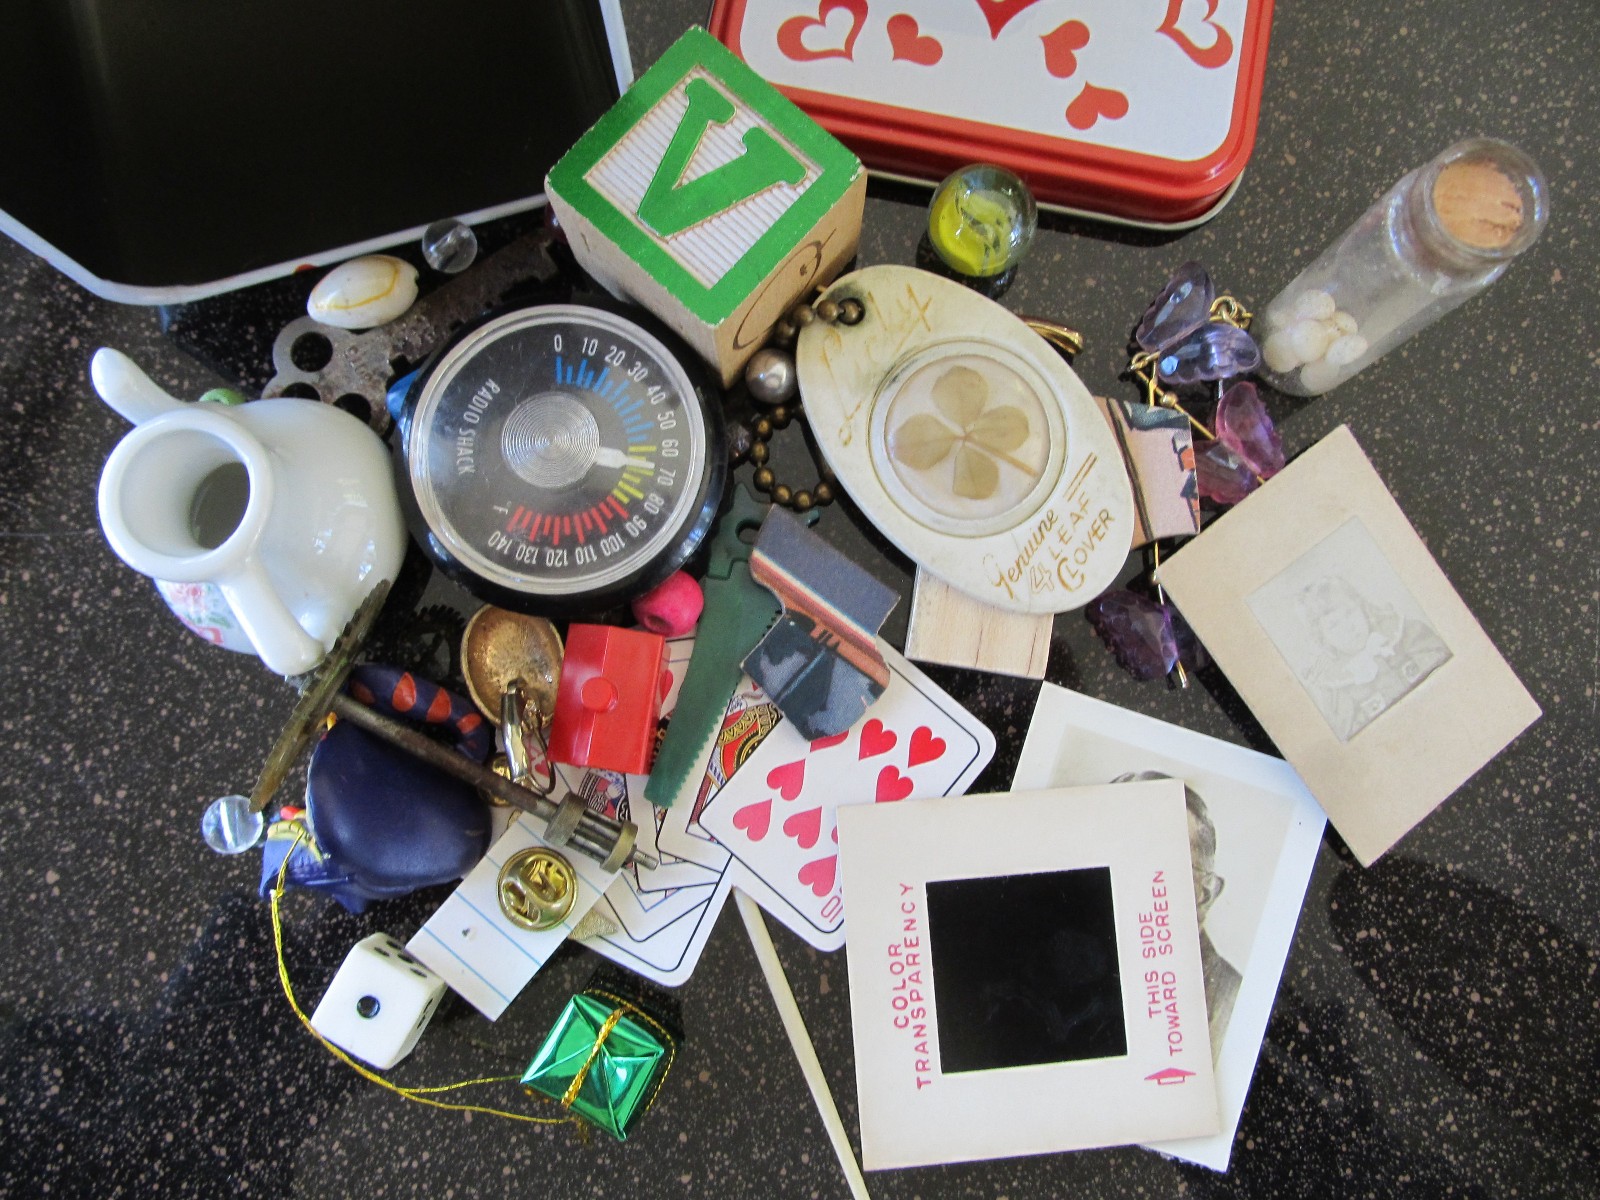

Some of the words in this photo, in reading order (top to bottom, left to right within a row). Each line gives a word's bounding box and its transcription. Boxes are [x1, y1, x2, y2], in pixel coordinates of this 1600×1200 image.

[636, 77, 808, 238] V
[553, 334, 563, 352] 0
[581, 336, 599, 357] 10
[604, 345, 626, 367] 20
[627, 361, 649, 383] 30
[463, 378, 501, 424] RADIO
[647, 384, 667, 406] 40
[656, 410, 677, 431] 50
[456, 428, 476, 476] SHACK
[661, 439, 680, 458] 60
[657, 468, 676, 487] 70
[643, 492, 665, 515] 80
[625, 515, 648, 538] 90
[487, 530, 513, 556] 140
[515, 544, 539, 565] 130
[575, 545, 598, 566] 110
[603, 532, 626, 557] 100
[983, 508, 1059, 601] Genuine
[1029, 562, 1055, 595] 4
[1048, 491, 1090, 561] LEAF
[1056, 508, 1116, 592] CLOVER
[545, 548, 569, 568] 120
[1152, 870, 1174, 956] SCREEN
[1138, 911, 1157, 959] SIDE
[887, 943, 910, 1029] COLOR
[899, 882, 932, 1090] TRANSPARENCY
[1144, 970, 1163, 1019] THIS
[1161, 970, 1184, 1057] TOWARD
